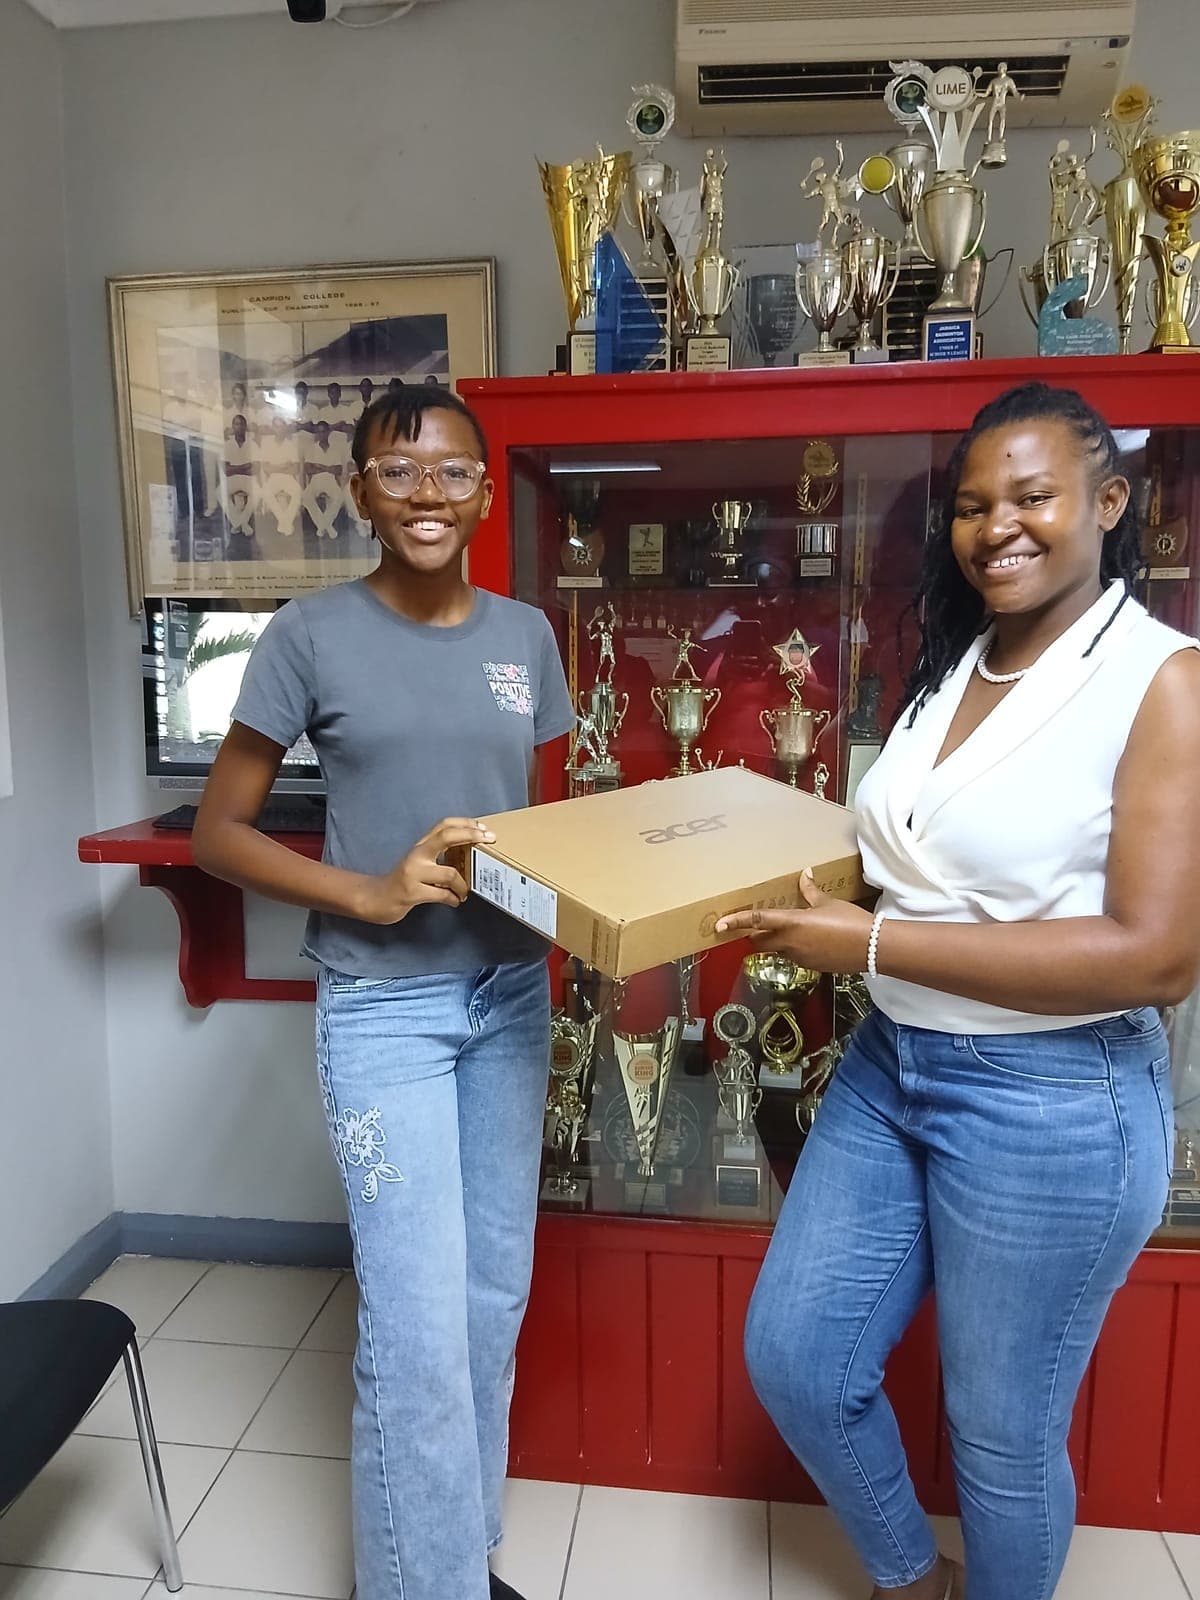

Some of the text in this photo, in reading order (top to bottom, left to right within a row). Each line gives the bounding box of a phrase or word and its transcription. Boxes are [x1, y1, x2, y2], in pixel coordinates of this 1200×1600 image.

[936, 83, 966, 95] LIME
[249, 292, 346, 303] CAMPION COLLEGE
[489, 681, 532, 700] POSITIVE
[639, 814, 728, 844] acer
